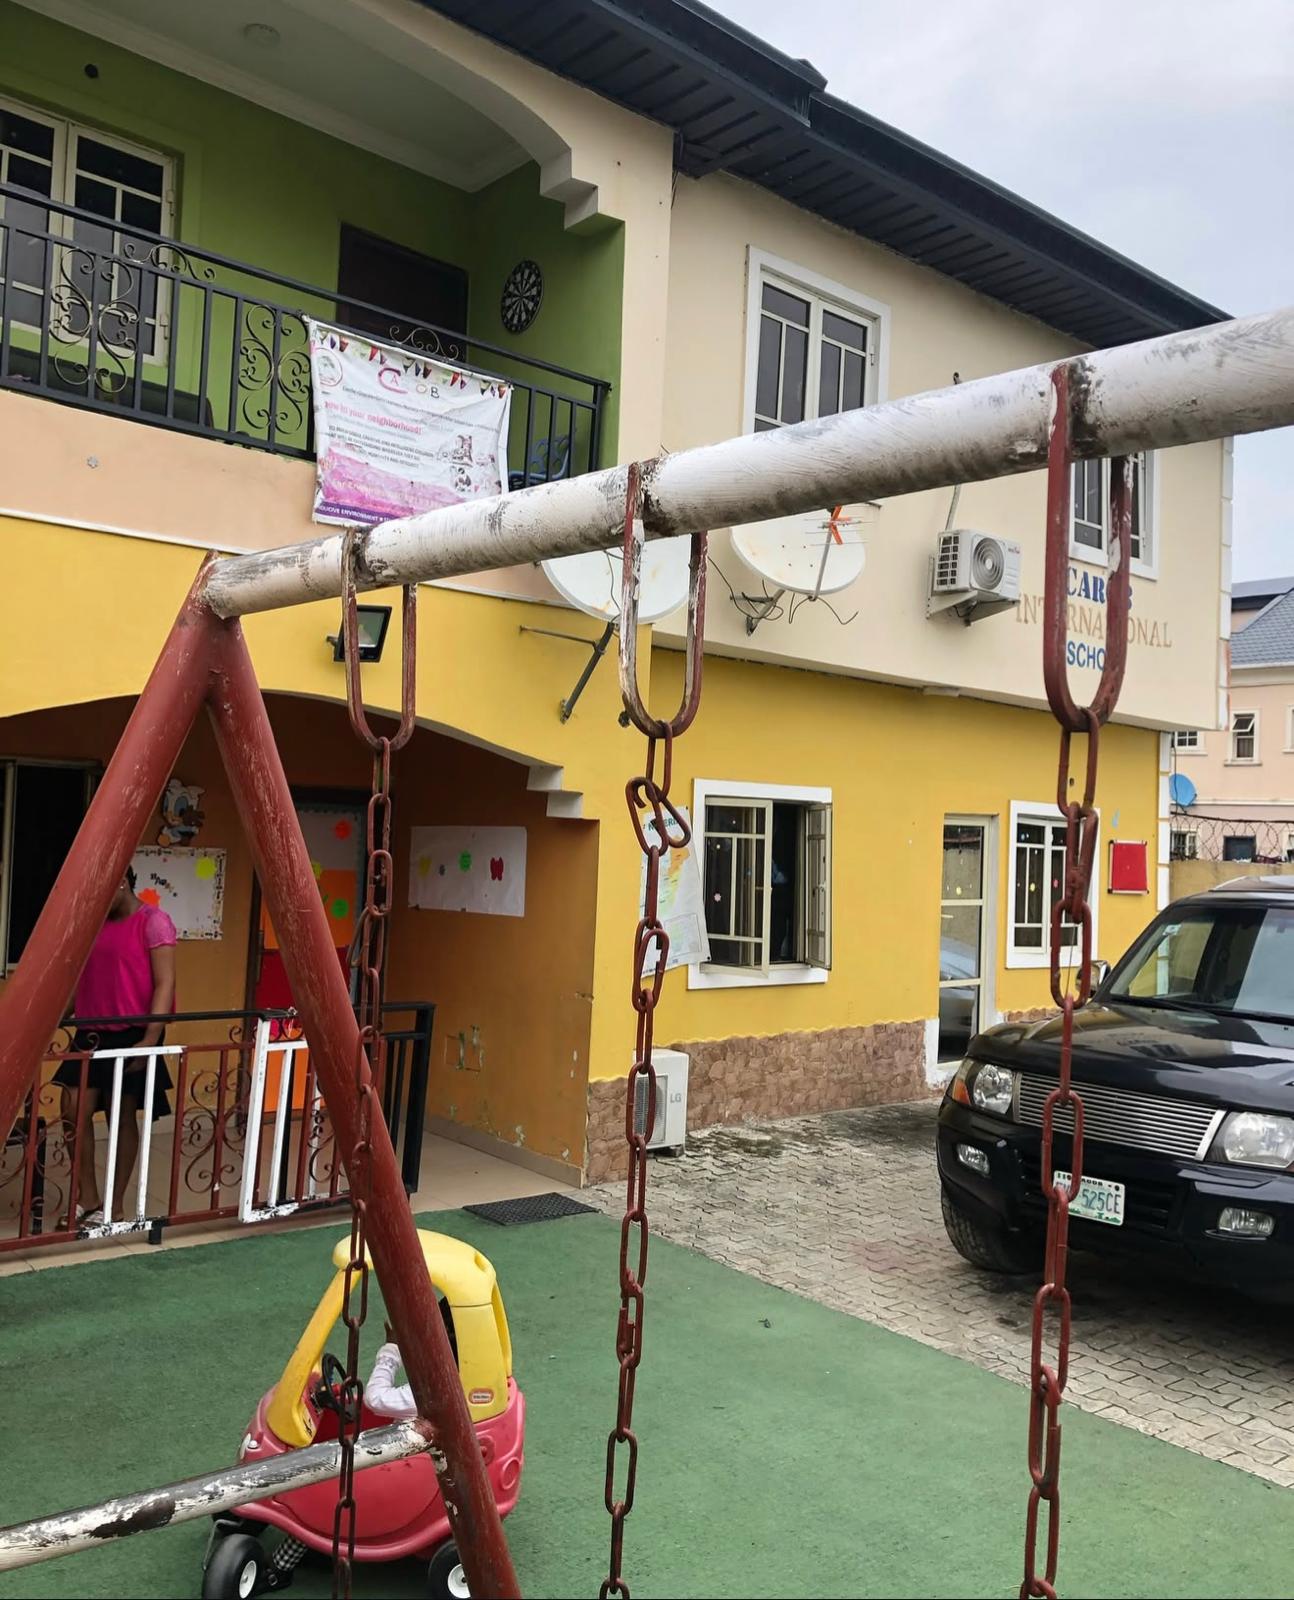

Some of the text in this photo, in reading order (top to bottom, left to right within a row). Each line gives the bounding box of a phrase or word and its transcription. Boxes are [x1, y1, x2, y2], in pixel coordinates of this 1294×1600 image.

[378, 368, 440, 399] CAOB
[1067, 567, 1132, 610] CAR
[1016, 593, 1172, 648] INRNAONAL
[1067, 640, 1108, 671] SCHO
[670, 1092, 682, 1104] LG
